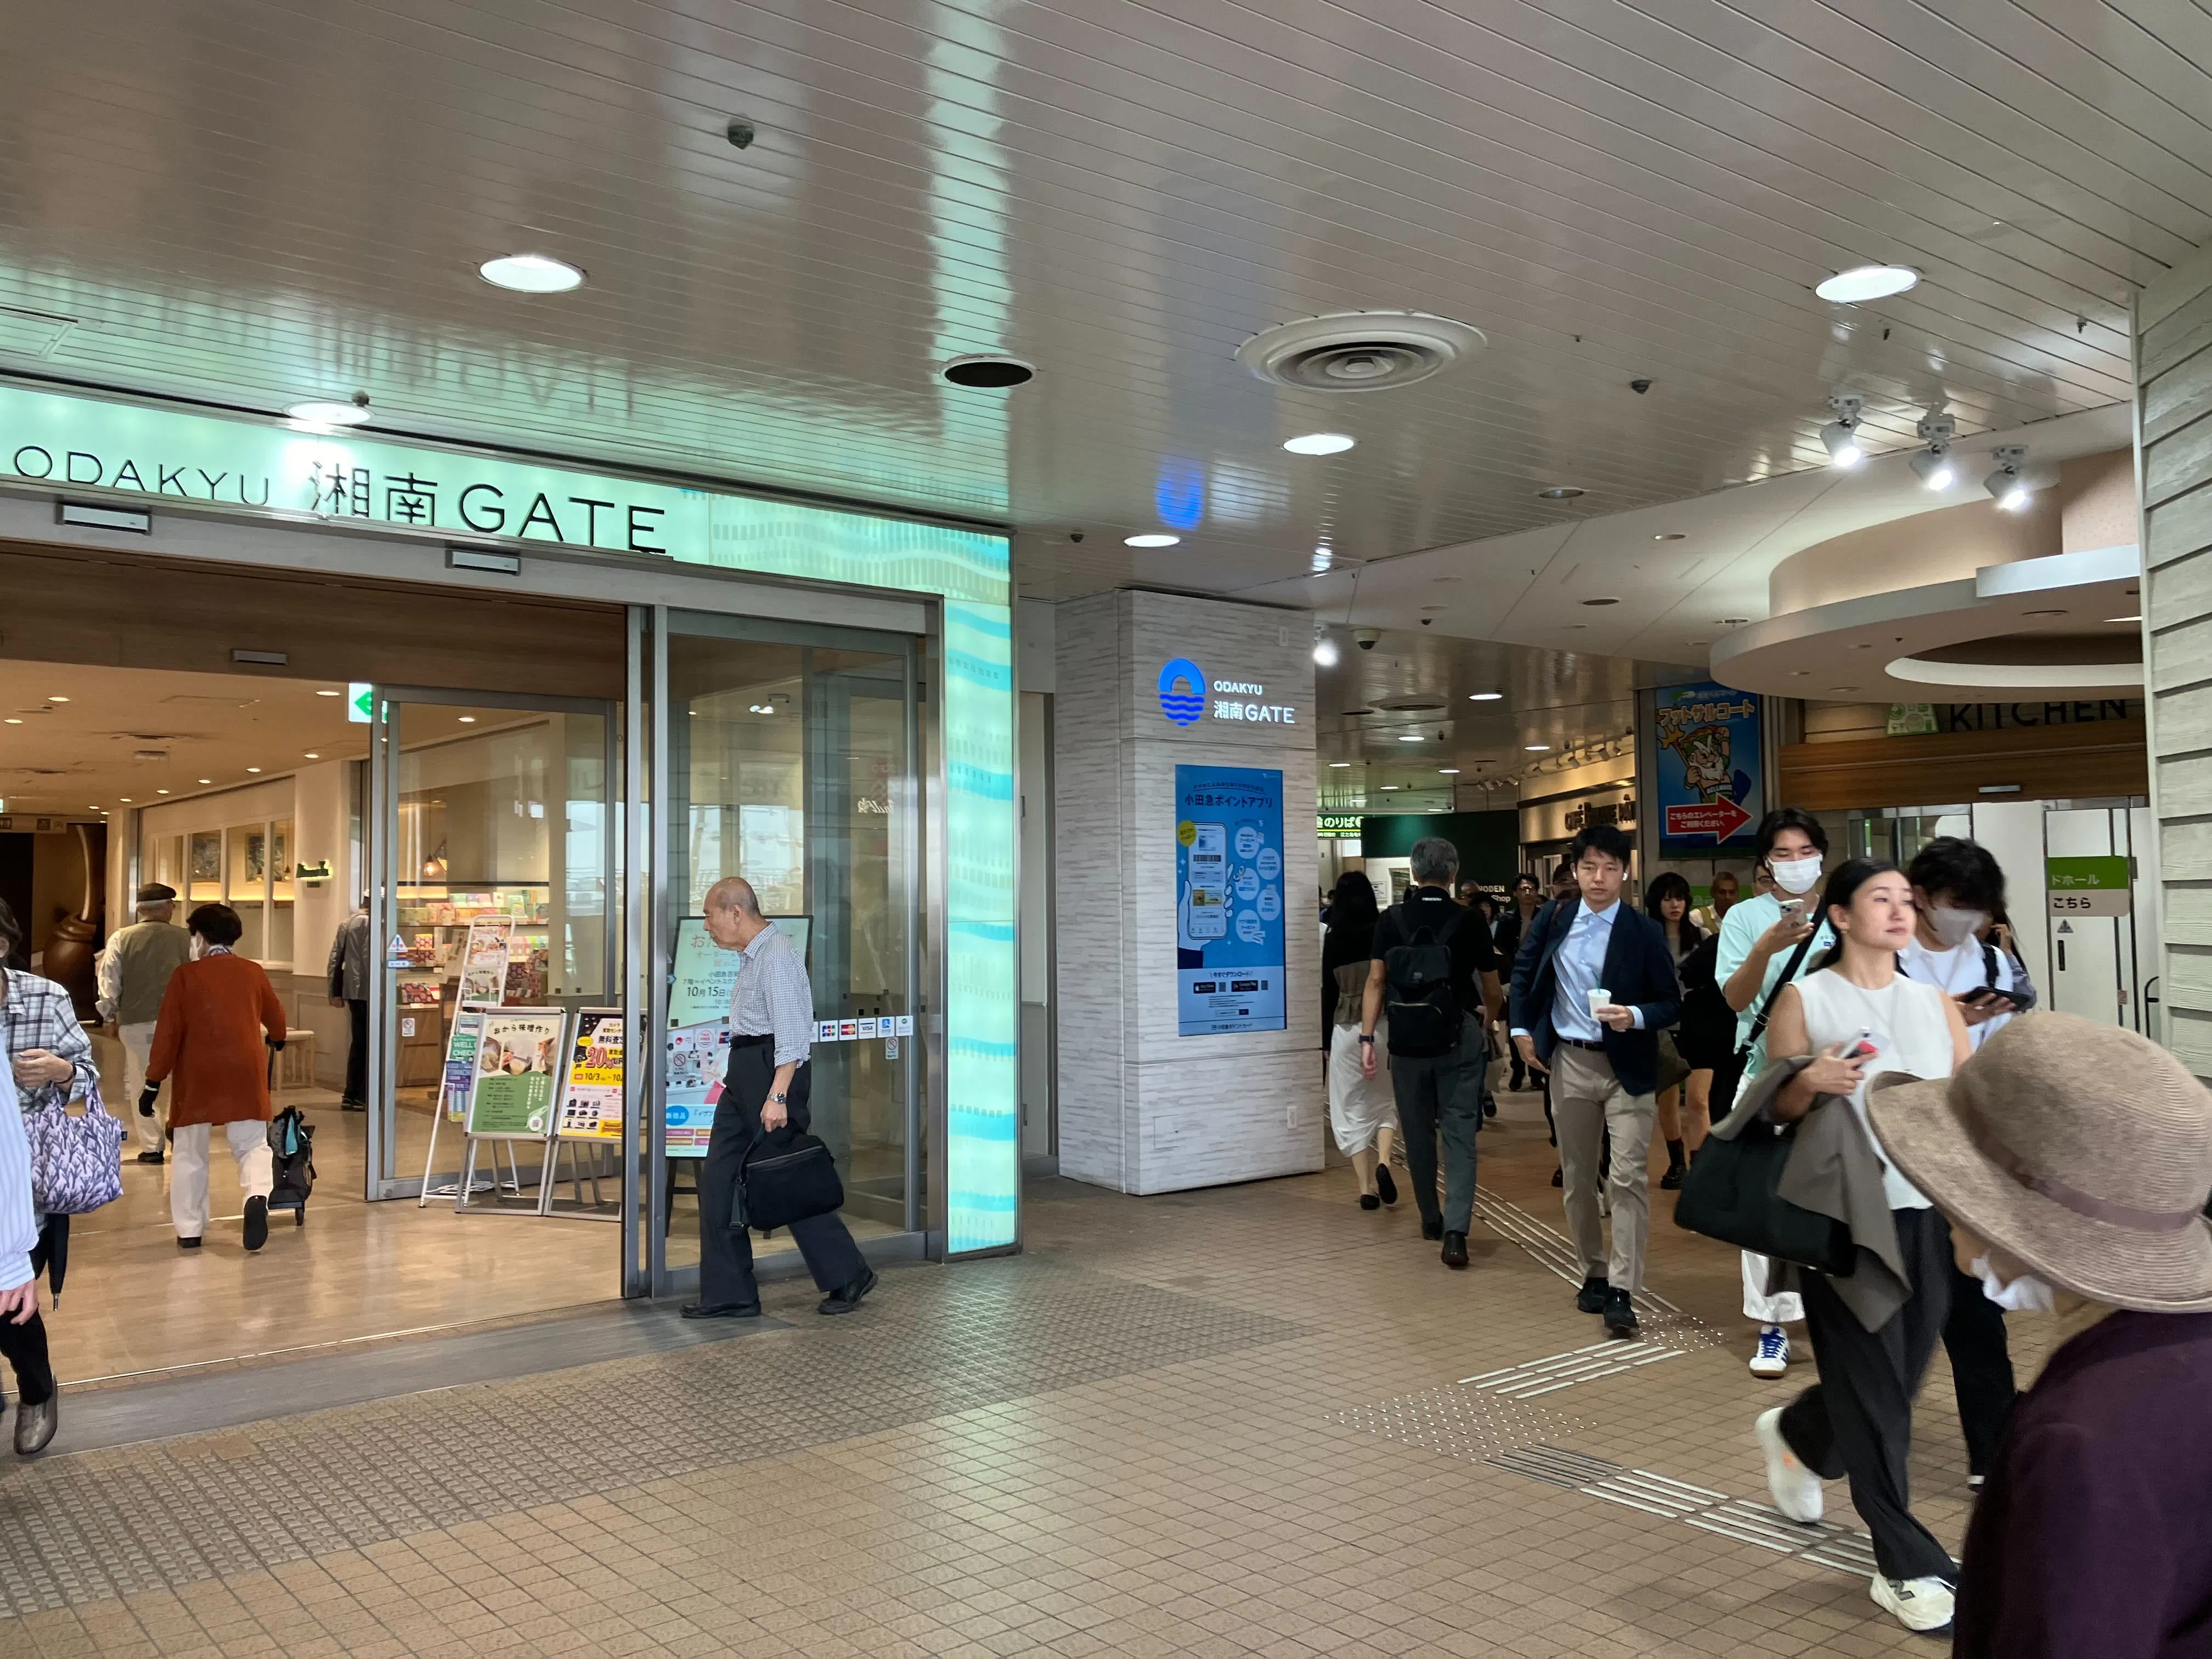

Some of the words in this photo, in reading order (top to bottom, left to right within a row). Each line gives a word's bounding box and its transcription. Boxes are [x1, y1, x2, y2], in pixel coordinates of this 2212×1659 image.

[14, 445, 269, 505] ODAKYU
[1213, 680, 1263, 696] ODAKYU
[1949, 699, 2128, 732] KITCHEN
[1184, 794, 1273, 808] 小田急ポイントアプリ
[2053, 896, 2091, 909] こちら
[493, 1023, 550, 1035] おから味噌作り
